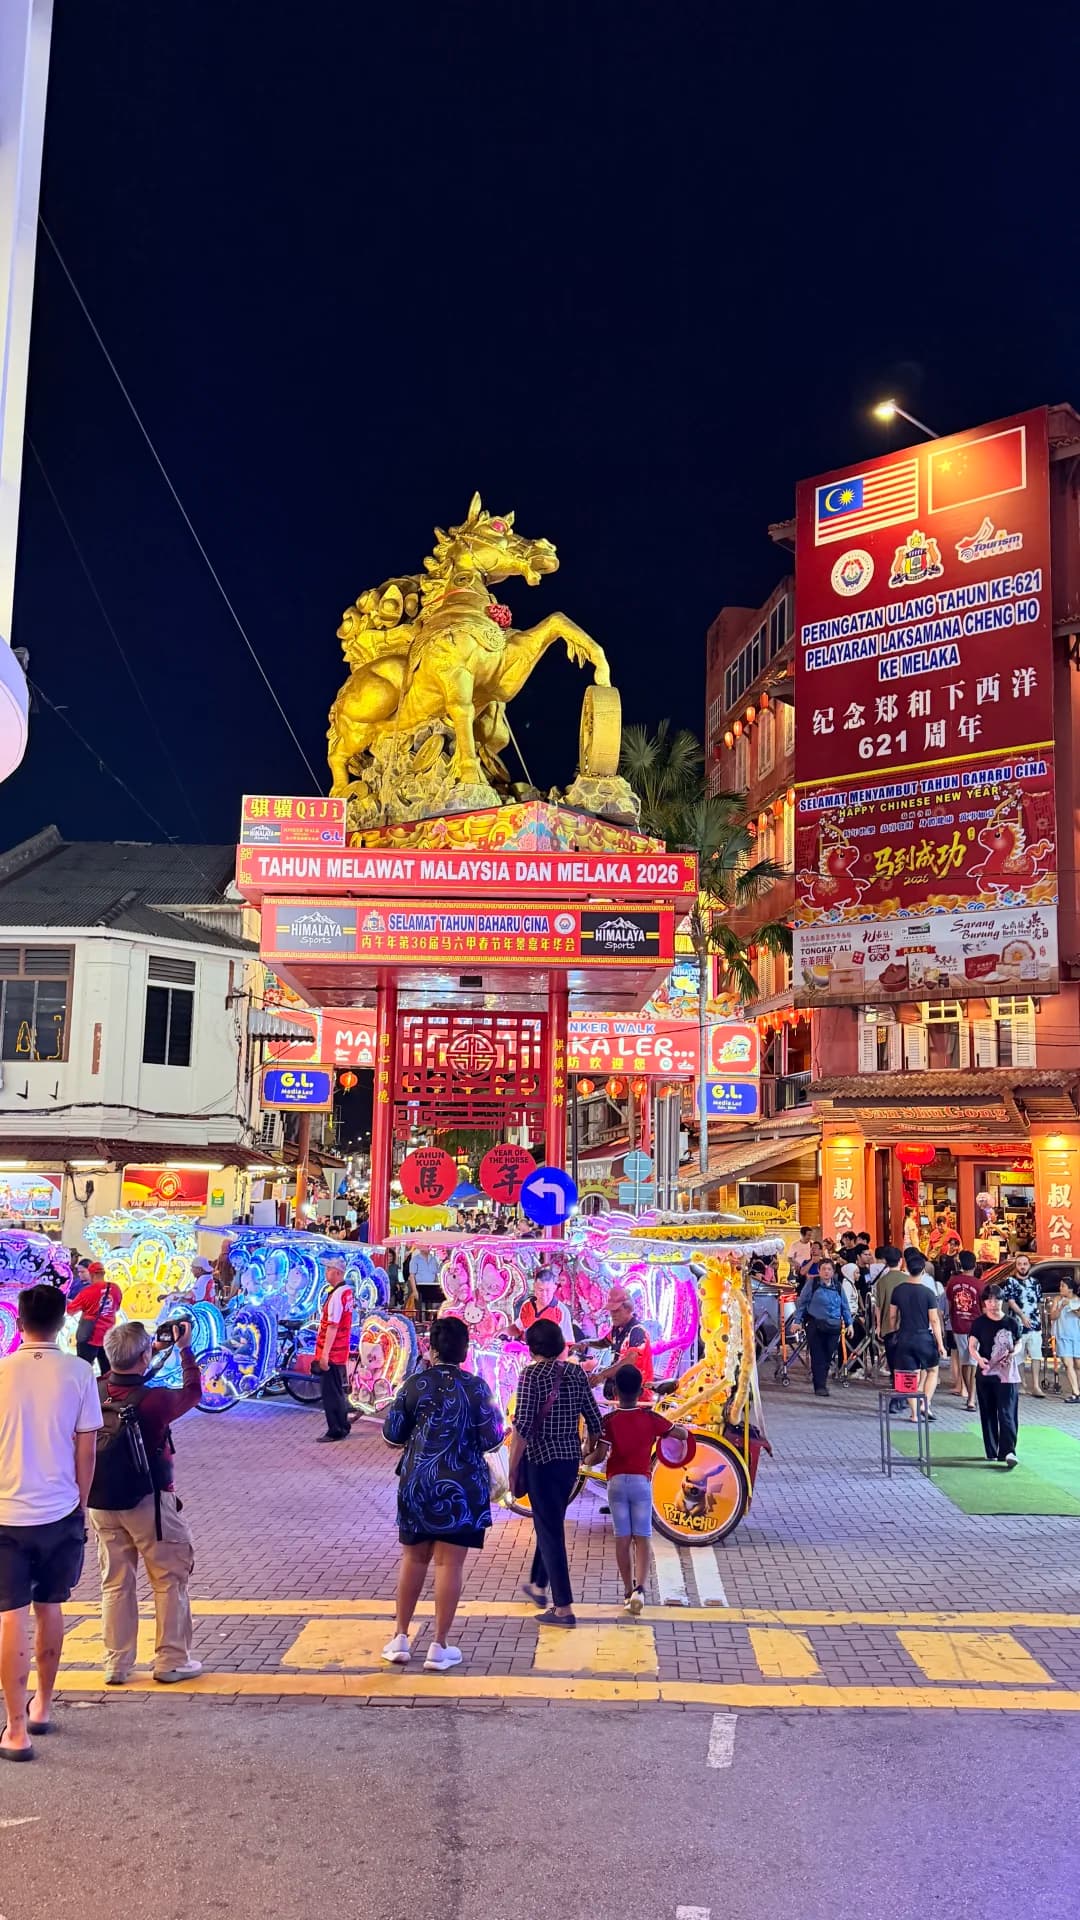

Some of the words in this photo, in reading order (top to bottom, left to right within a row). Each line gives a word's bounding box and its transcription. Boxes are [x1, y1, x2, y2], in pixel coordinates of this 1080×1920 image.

[974, 535, 1020, 553] Tourism
[802, 608, 884, 645] PERINGATAN
[887, 597, 935, 624] ULANG
[938, 583, 987, 612] TAHUN
[991, 570, 1041, 600] KE-621
[807, 636, 878, 670] PELAYARAN
[880, 617, 962, 653] LAKSAMANA
[964, 605, 1014, 634] CHENG
[1016, 599, 1039, 623] HO
[879, 658, 899, 681] KE
[901, 645, 960, 677] MELAKA
[812, 667, 1038, 735] 纪念郑和下西洋
[799, 793, 847, 812] SELAMAT
[850, 782, 918, 804] MENYAMBUT
[920, 776, 960, 794] TAHUN
[962, 768, 1011, 786] BAHARU
[1015, 762, 1047, 777] CINA
[838, 804, 875, 818] HAPPY
[880, 797, 931, 812] CHINESE
[935, 791, 962, 804] NEW
[966, 786, 1000, 799] YEAR
[321, 831, 344, 841] G.L.
[869, 830, 967, 884] 马到成功
[258, 856, 321, 878] TAHUN
[326, 858, 416, 880] MELAWAT
[420, 860, 510, 881] MALAYSIA
[515, 861, 552, 882] DAN
[557, 862, 632, 883] MELAKA
[636, 863, 679, 884] 2026
[903, 874, 929, 886] 2026
[291, 923, 342, 937] HIMALAYA
[388, 914, 437, 931] SELAMAT
[439, 915, 475, 932] TAHUN
[478, 915, 521, 932] BAHARU
[523, 916, 549, 933] CINA
[951, 919, 995, 933] Sarang
[595, 928, 646, 942] HIMALAYA
[961, 927, 1000, 940] Burung
[300, 936, 332, 947] Sports
[604, 941, 636, 952] Sports
[800, 945, 837, 956] TONGKAT
[839, 943, 852, 952] ALI
[614, 1022, 656, 1034] WALK
[618, 1037, 696, 1058] LER...
[280, 1072, 315, 1088] G.L.
[711, 1084, 743, 1099] G.L.
[861, 1107, 901, 1119] San
[902, 1106, 945, 1119] Shu
[945, 1105, 1011, 1123] Gong
[413, 1151, 445, 1159] TAHUN
[488, 1156, 503, 1164] THE
[504, 1156, 529, 1164] HORSE
[493, 1149, 512, 1157] YEAR
[514, 1149, 525, 1157] OF
[415, 1159, 442, 1167] KUDA
[414, 1166, 445, 1199] 馬
[492, 1163, 523, 1197] 年
[742, 1209, 773, 1217] Malacca
[662, 1502, 719, 1532] PIKACHU
